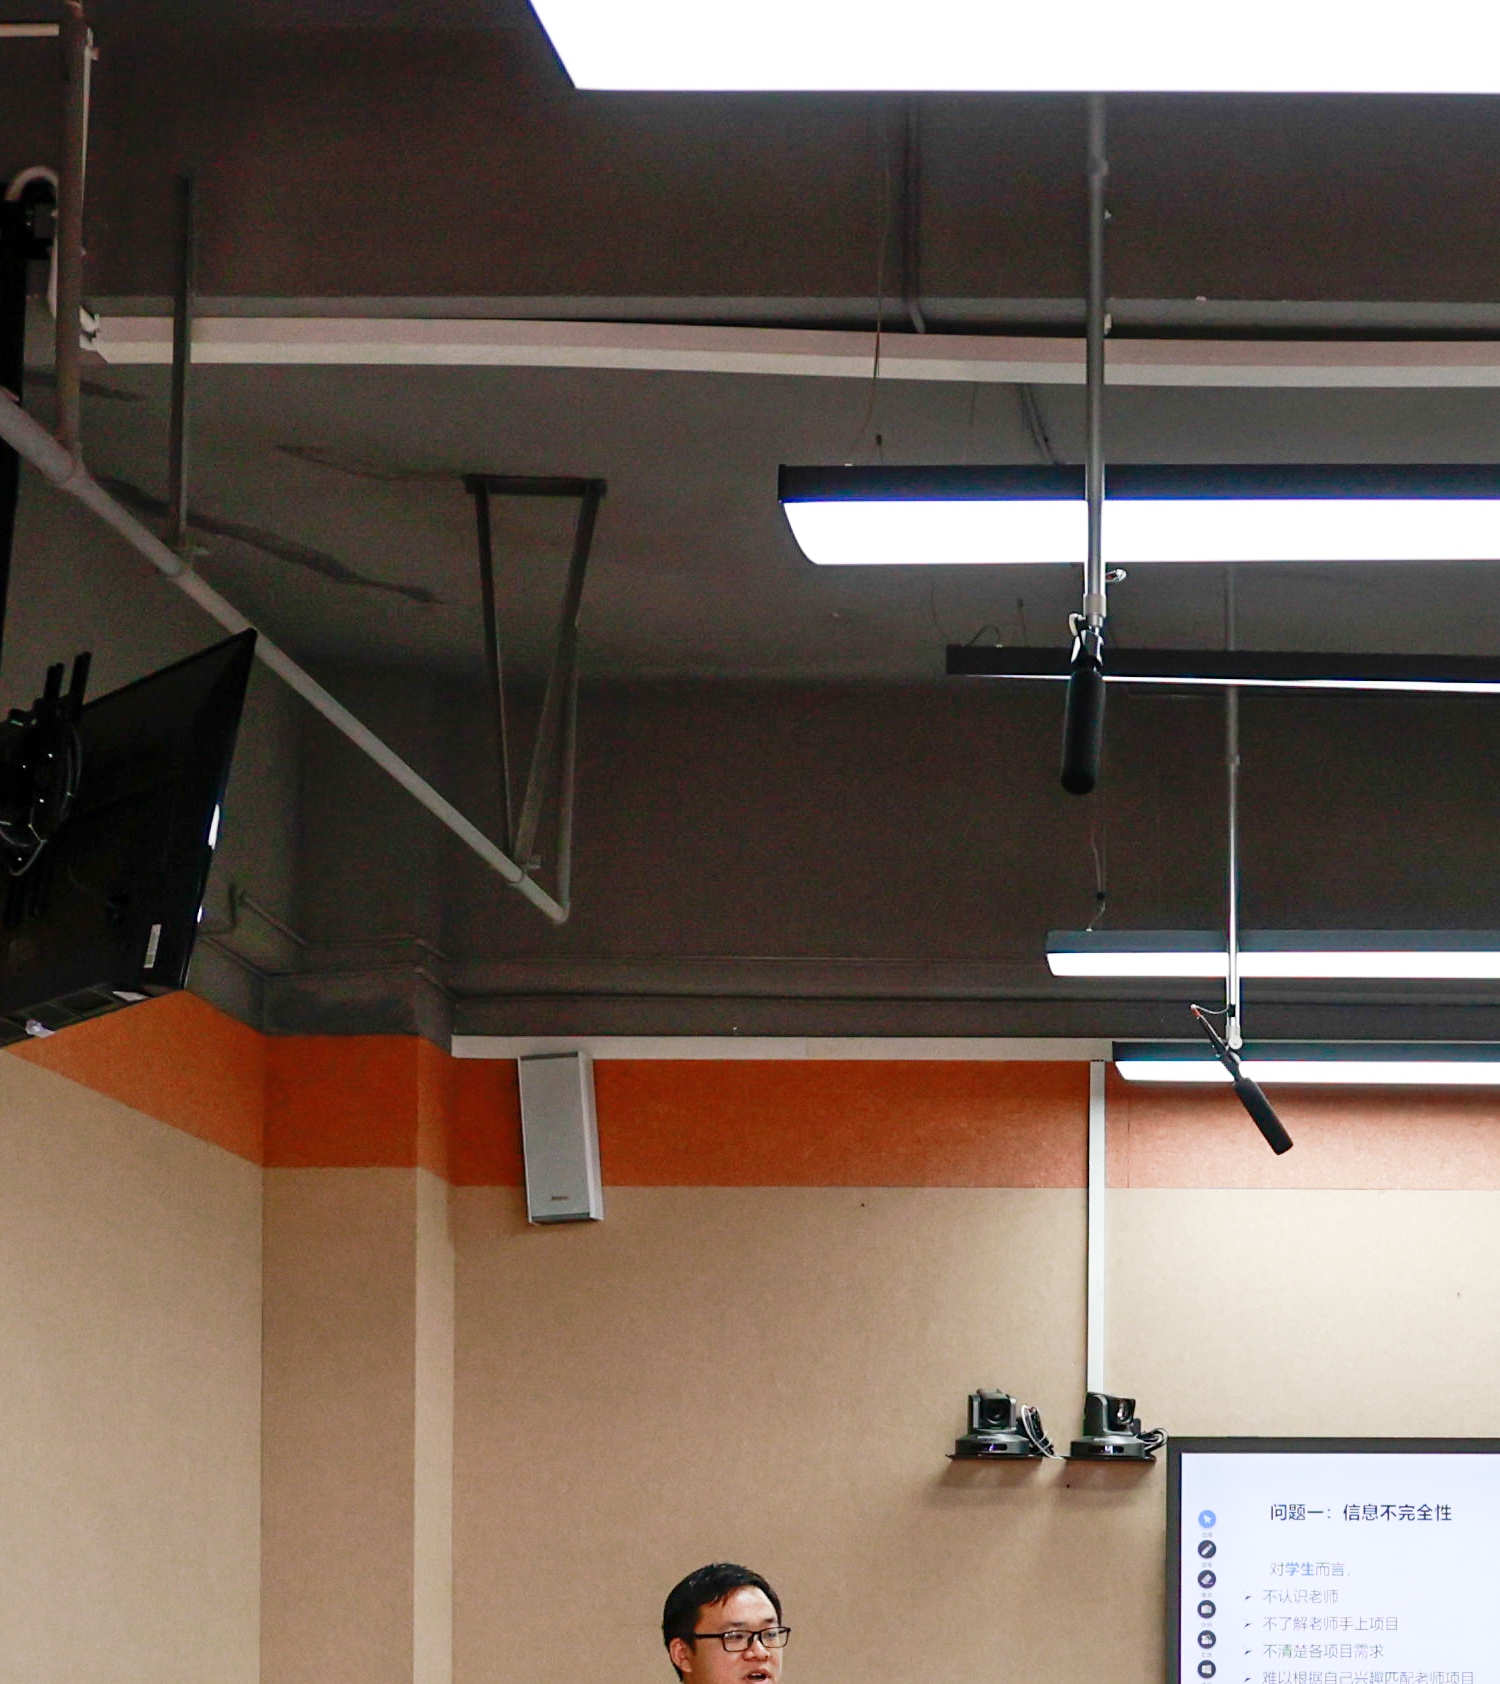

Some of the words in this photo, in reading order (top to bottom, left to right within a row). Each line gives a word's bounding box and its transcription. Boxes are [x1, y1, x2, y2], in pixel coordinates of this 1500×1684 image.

[1270, 1503, 1453, 1522] 问题一：信息不完全性
[1263, 1589, 1339, 1604] 不认识老师
[1263, 1616, 1398, 1631] 不了解老师手上项目
[1263, 1644, 1385, 1659] 不清楚各项目需求
